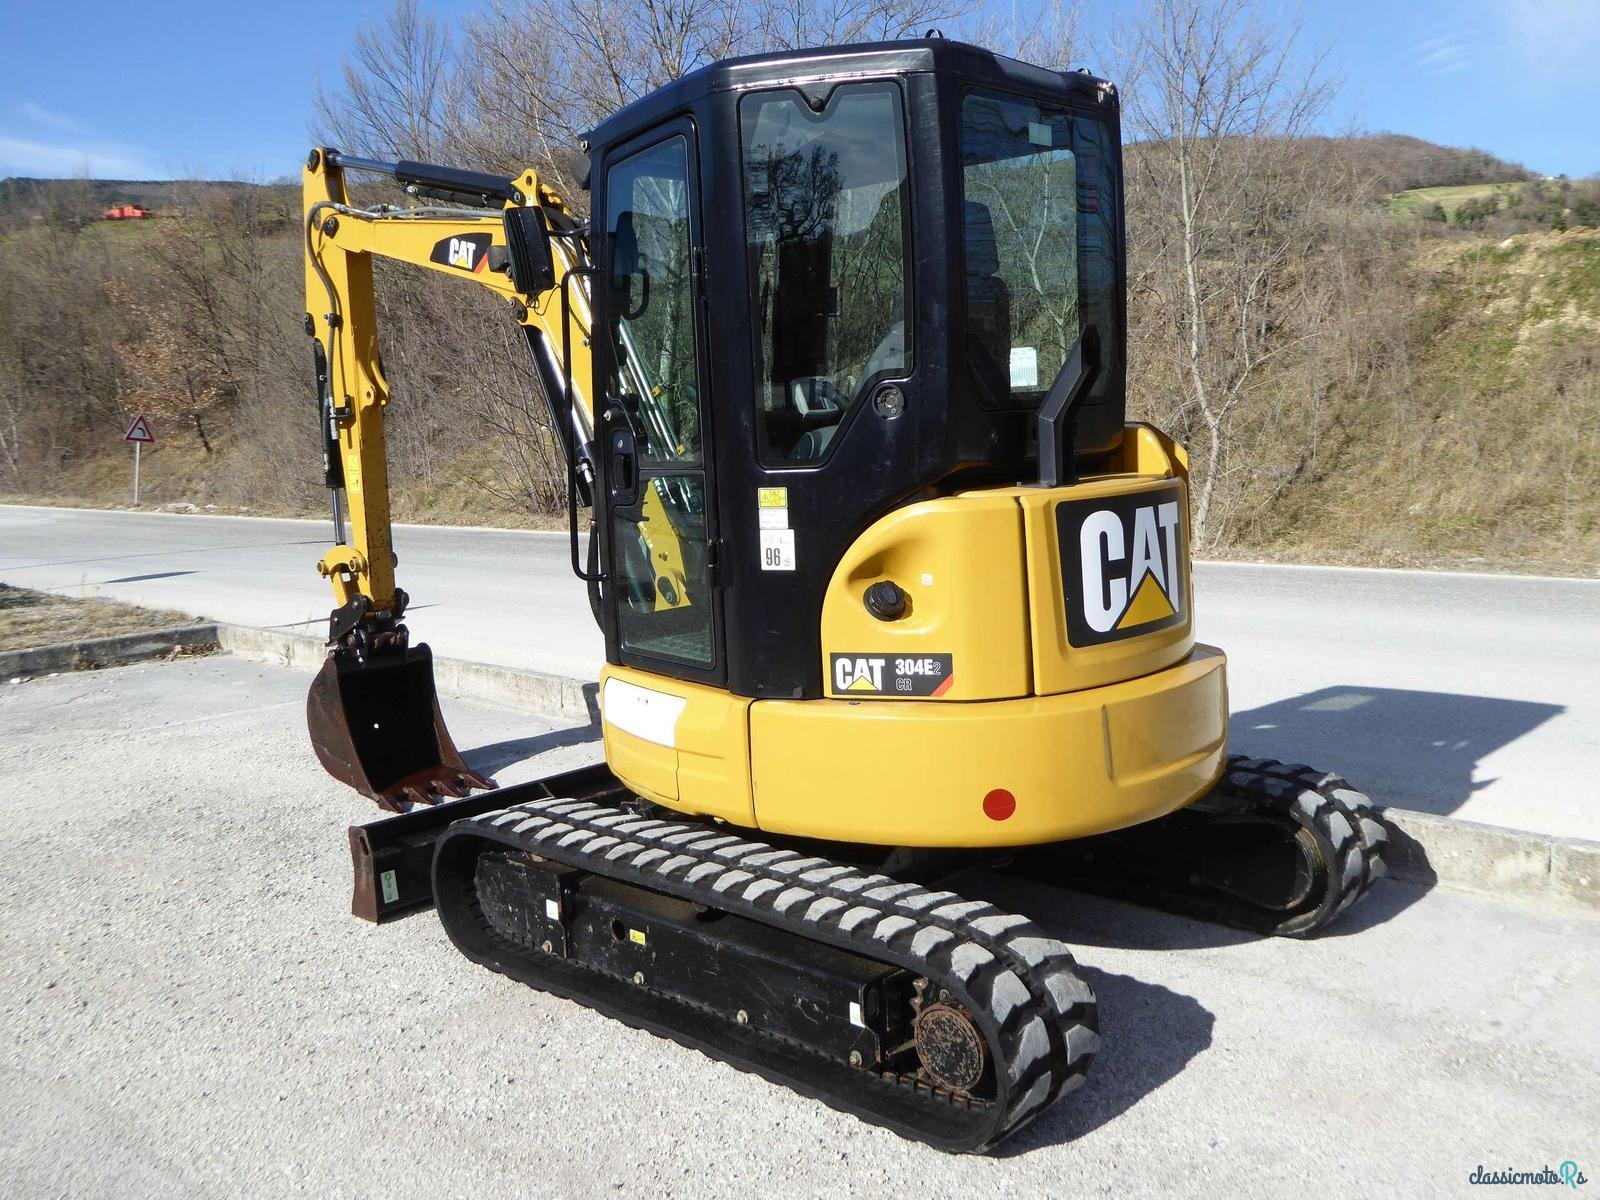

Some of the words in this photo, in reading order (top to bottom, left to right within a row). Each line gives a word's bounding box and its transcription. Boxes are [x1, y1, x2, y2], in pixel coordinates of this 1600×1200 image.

[448, 238, 476, 269] CAT
[765, 547, 781, 566] 96
[1080, 501, 1180, 633] CAT
[835, 657, 886, 691] CAT
[895, 658, 942, 675] 304E2
[896, 678, 912, 691] CR
